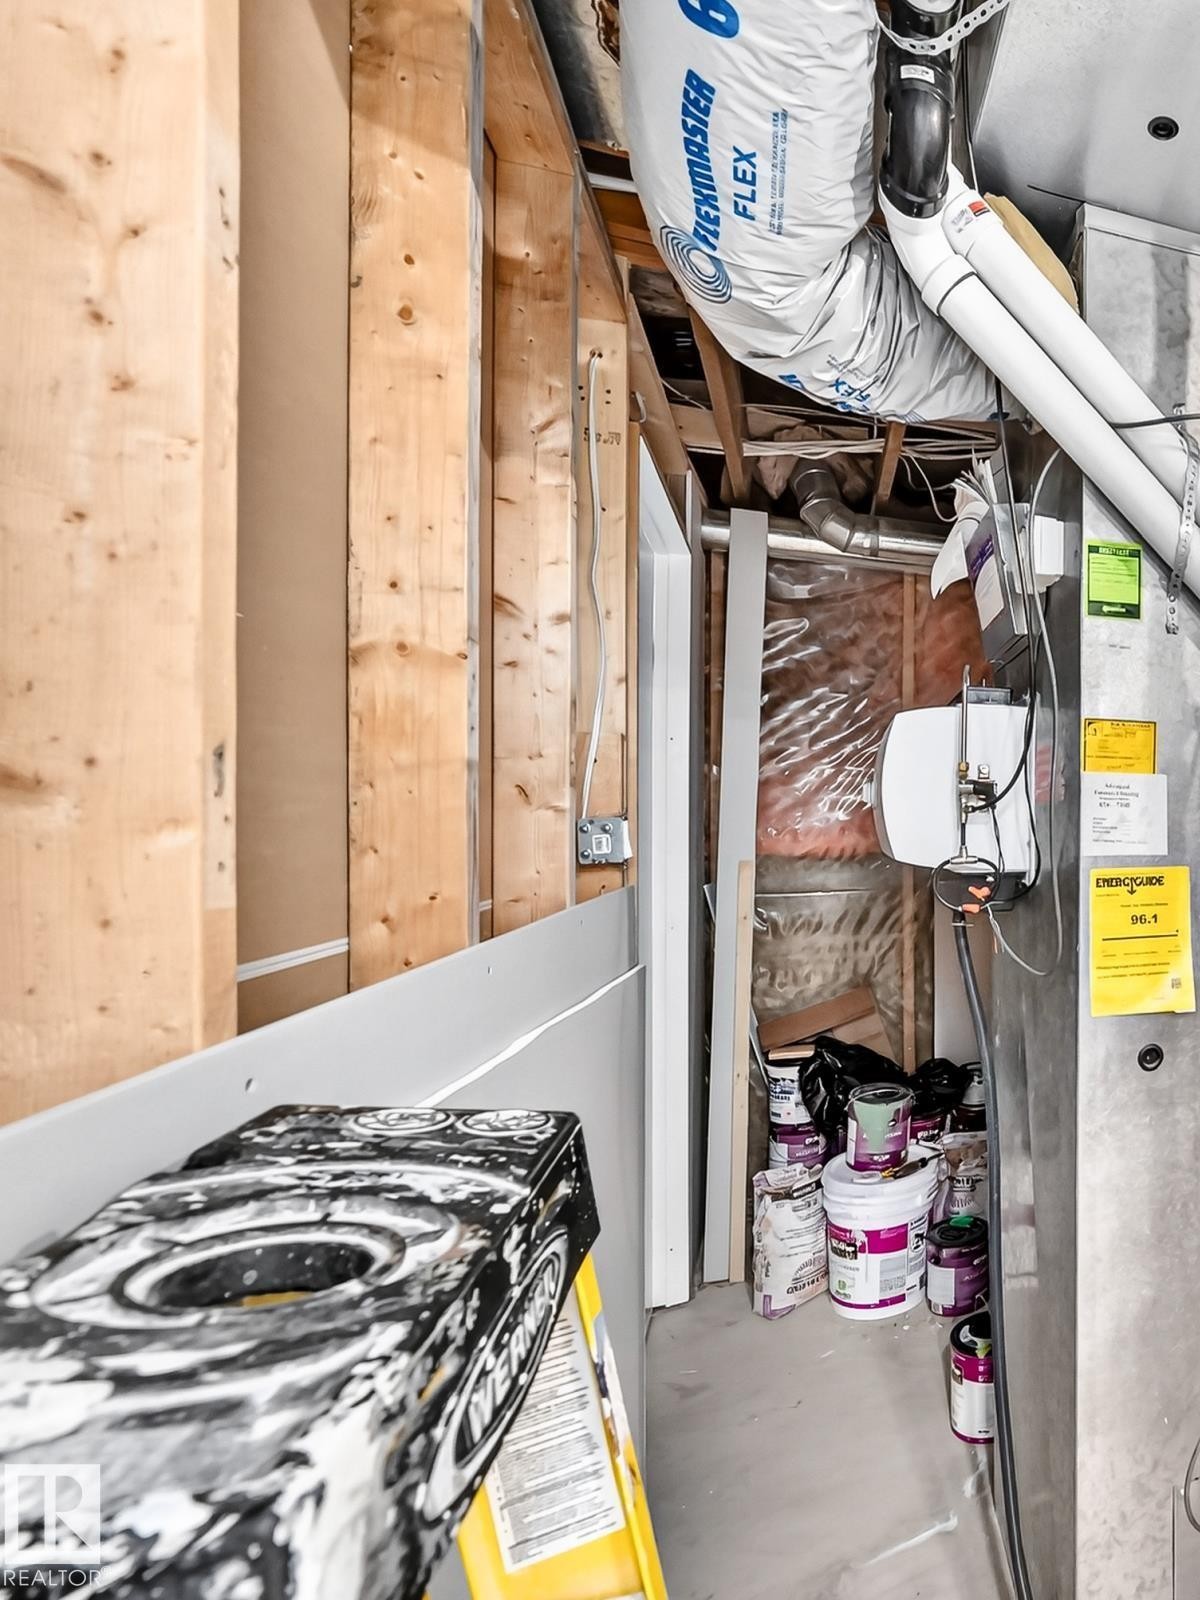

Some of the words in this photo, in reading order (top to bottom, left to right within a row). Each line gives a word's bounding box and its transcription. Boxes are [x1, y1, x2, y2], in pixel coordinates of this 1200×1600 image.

[681, 68, 721, 251] FLEXMASTER
[732, 145, 757, 222] FLEX
[1130, 913, 1159, 925] 96.1
